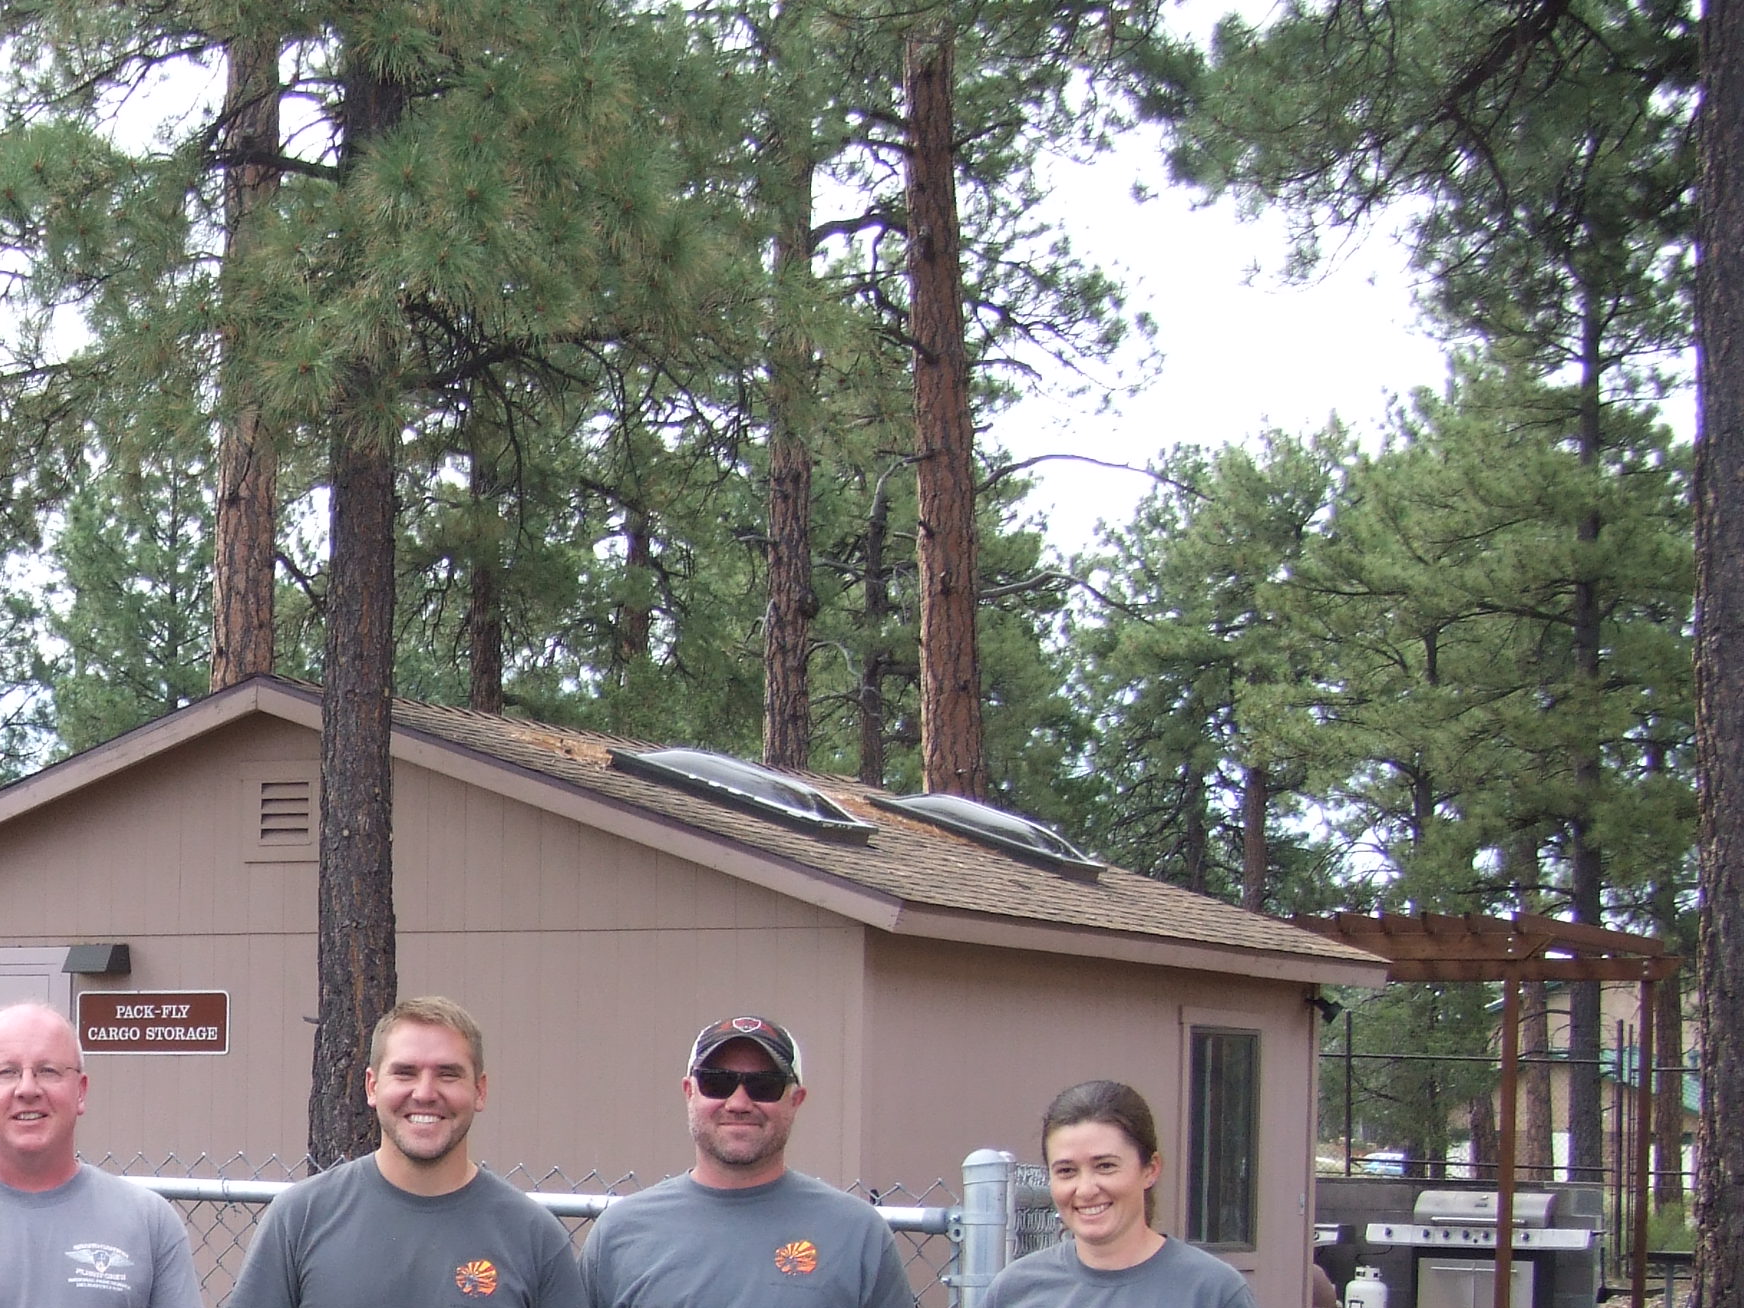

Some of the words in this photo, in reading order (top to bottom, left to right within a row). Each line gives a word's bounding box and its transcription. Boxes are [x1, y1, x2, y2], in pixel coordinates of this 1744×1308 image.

[115, 1005, 190, 1019] PACK-FLY
[87, 1027, 140, 1041] CARGO
[145, 1027, 218, 1041] STORAGE
